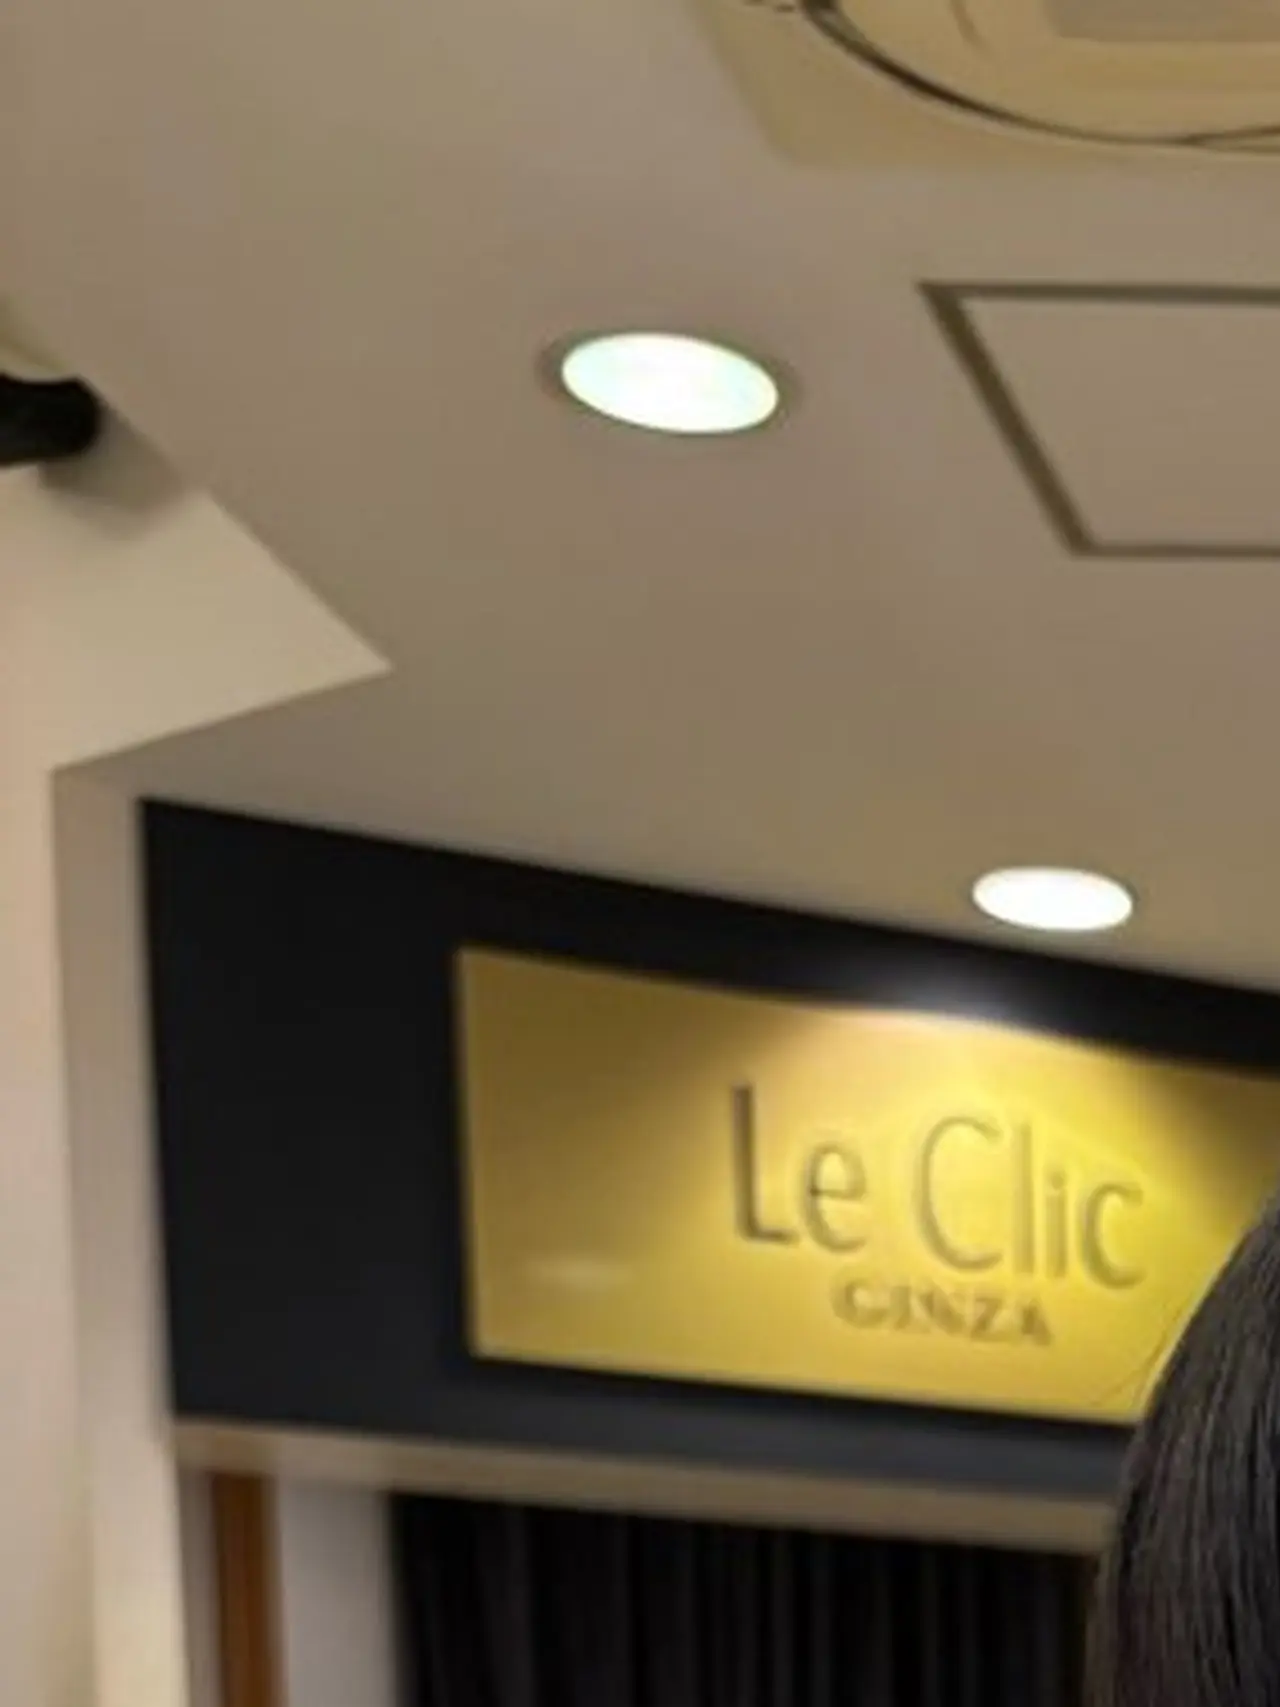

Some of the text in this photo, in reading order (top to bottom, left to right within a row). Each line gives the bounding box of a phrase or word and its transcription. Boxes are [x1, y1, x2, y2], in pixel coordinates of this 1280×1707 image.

[732, 1084, 1145, 1290] Le Clic
[833, 1277, 1053, 1346] GINZA
